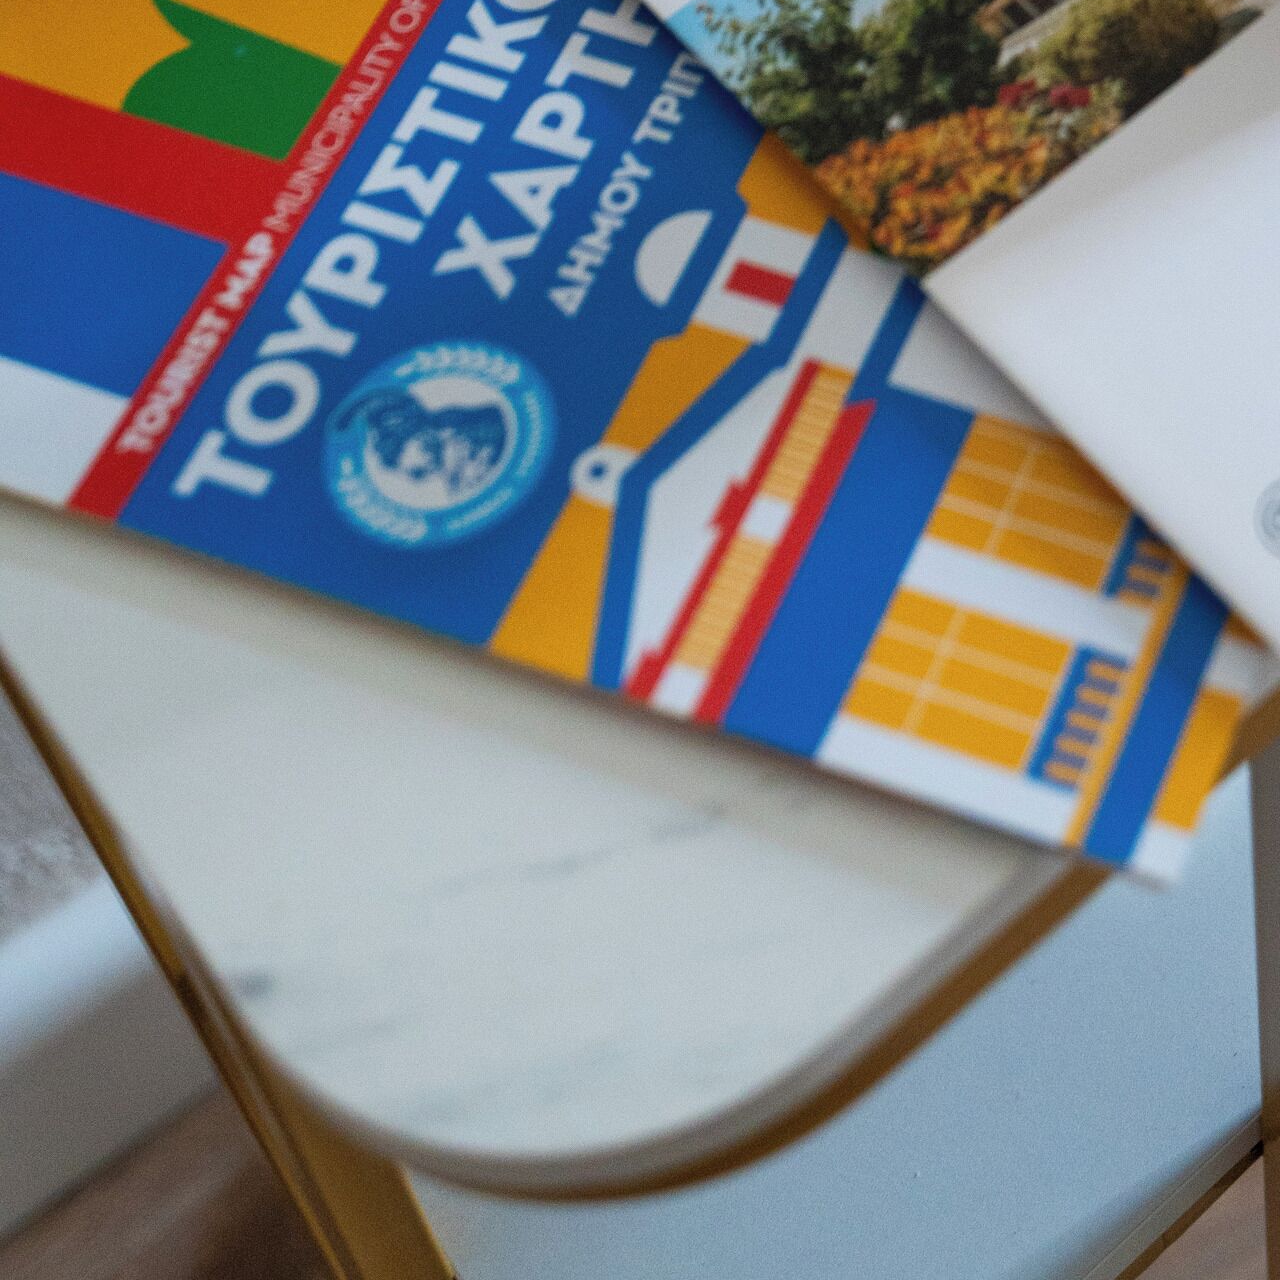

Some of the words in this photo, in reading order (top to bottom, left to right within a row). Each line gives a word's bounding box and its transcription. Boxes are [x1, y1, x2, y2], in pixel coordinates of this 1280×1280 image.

[116, 305, 231, 455] TOURIST
[215, 230, 276, 310] MAP
[262, 32, 397, 234] MUNICIPALITY
[548, 150, 654, 318] ΔΗΜΟΥ
